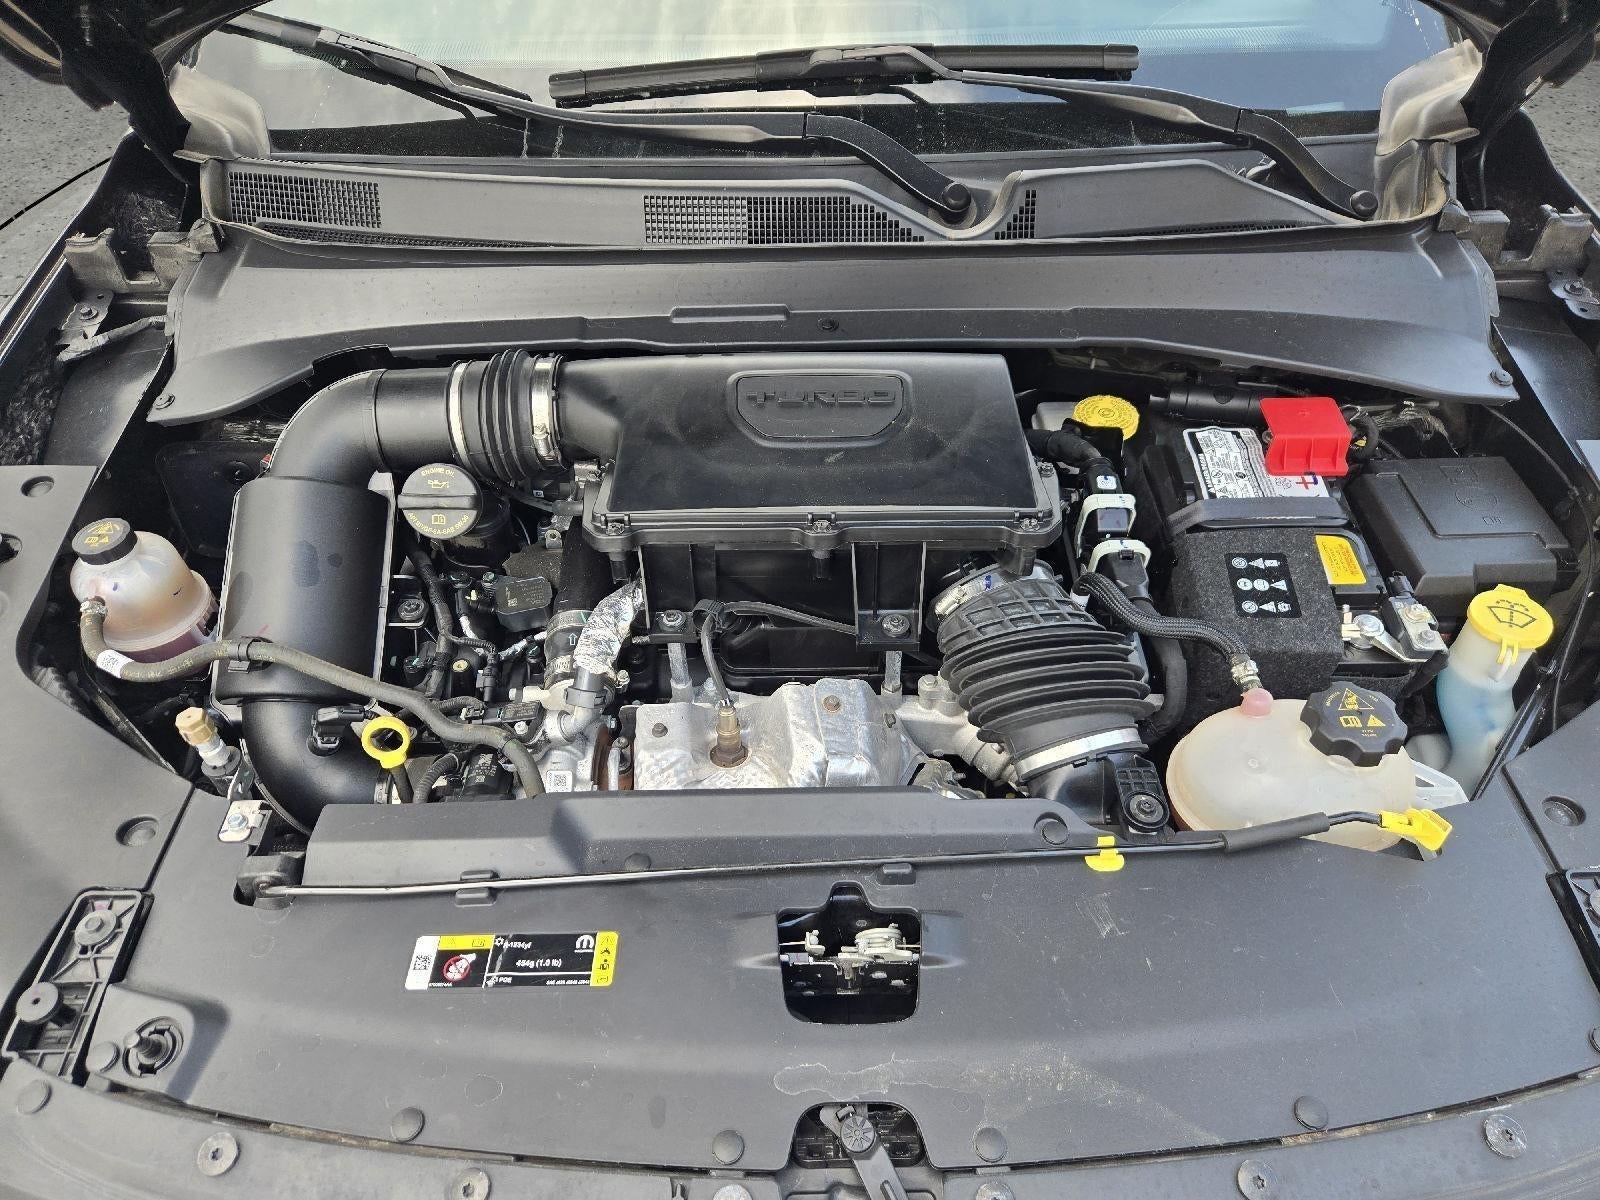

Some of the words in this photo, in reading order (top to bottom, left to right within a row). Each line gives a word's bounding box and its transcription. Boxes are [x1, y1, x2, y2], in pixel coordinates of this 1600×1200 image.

[746, 391, 896, 408] TURBO
[421, 467, 445, 477] ENGINE
[445, 469, 455, 478] OIL
